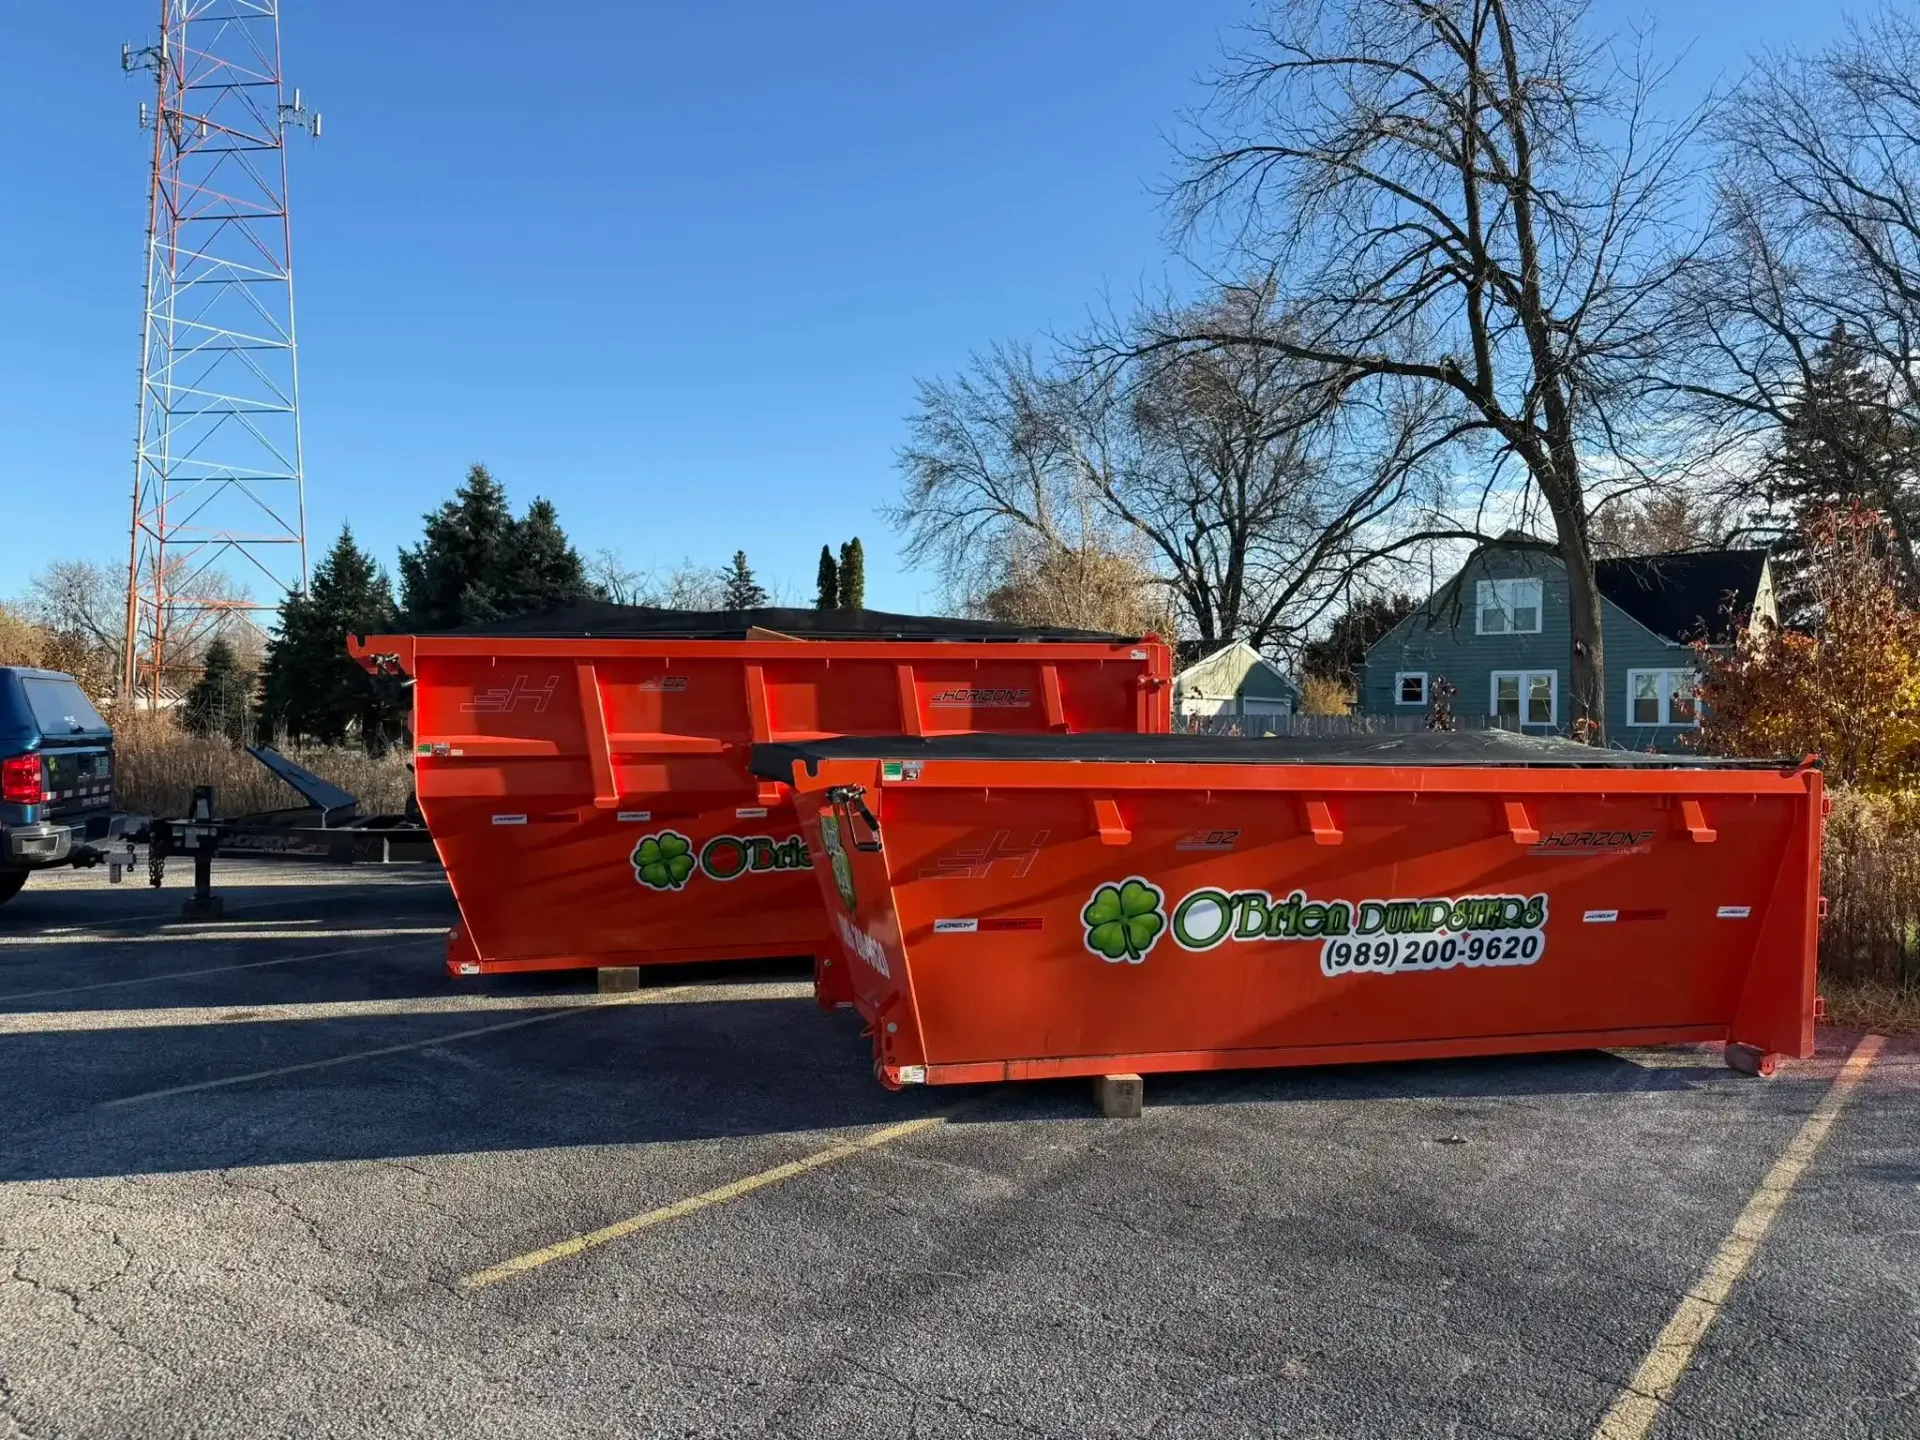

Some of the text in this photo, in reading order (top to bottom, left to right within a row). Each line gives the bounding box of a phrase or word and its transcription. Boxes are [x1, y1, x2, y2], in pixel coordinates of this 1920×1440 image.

[940, 689, 1022, 701] HORIZON
[1543, 831, 1645, 847] HORIZON
[1174, 890, 1544, 948] O'Brien DUMPSTERS
[1326, 935, 1538, 969] (989) 200-9620
